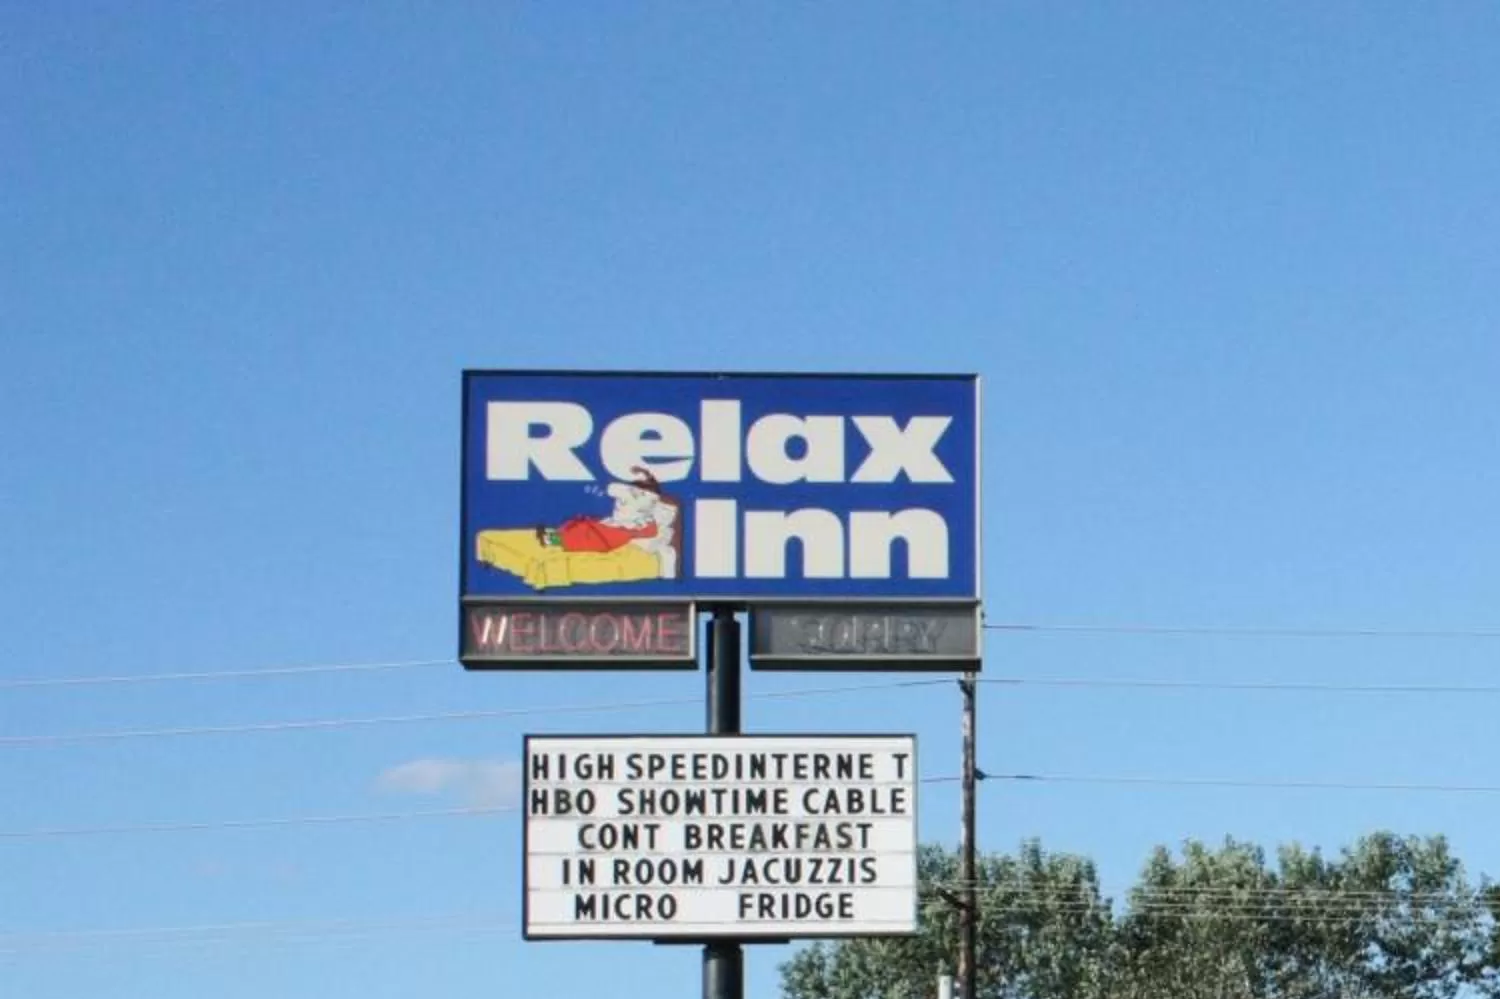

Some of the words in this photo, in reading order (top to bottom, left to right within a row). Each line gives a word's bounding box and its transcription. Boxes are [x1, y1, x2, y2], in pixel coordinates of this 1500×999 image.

[485, 399, 955, 484] Relax
[694, 499, 949, 579] Inn
[471, 612, 681, 652] WELCOME
[531, 753, 615, 781] HIGH
[531, 788, 596, 816] HBO
[617, 787, 788, 816] SHOWTIME
[802, 787, 905, 815] CABLE
[577, 823, 661, 851] CONT
[684, 821, 873, 851] BREAKFAST
[562, 858, 595, 885] IN
[613, 858, 704, 886] ROOM
[718, 857, 877, 885] JACUZZIS
[574, 893, 677, 921] MICRO
[738, 892, 854, 919] FRIDGE
